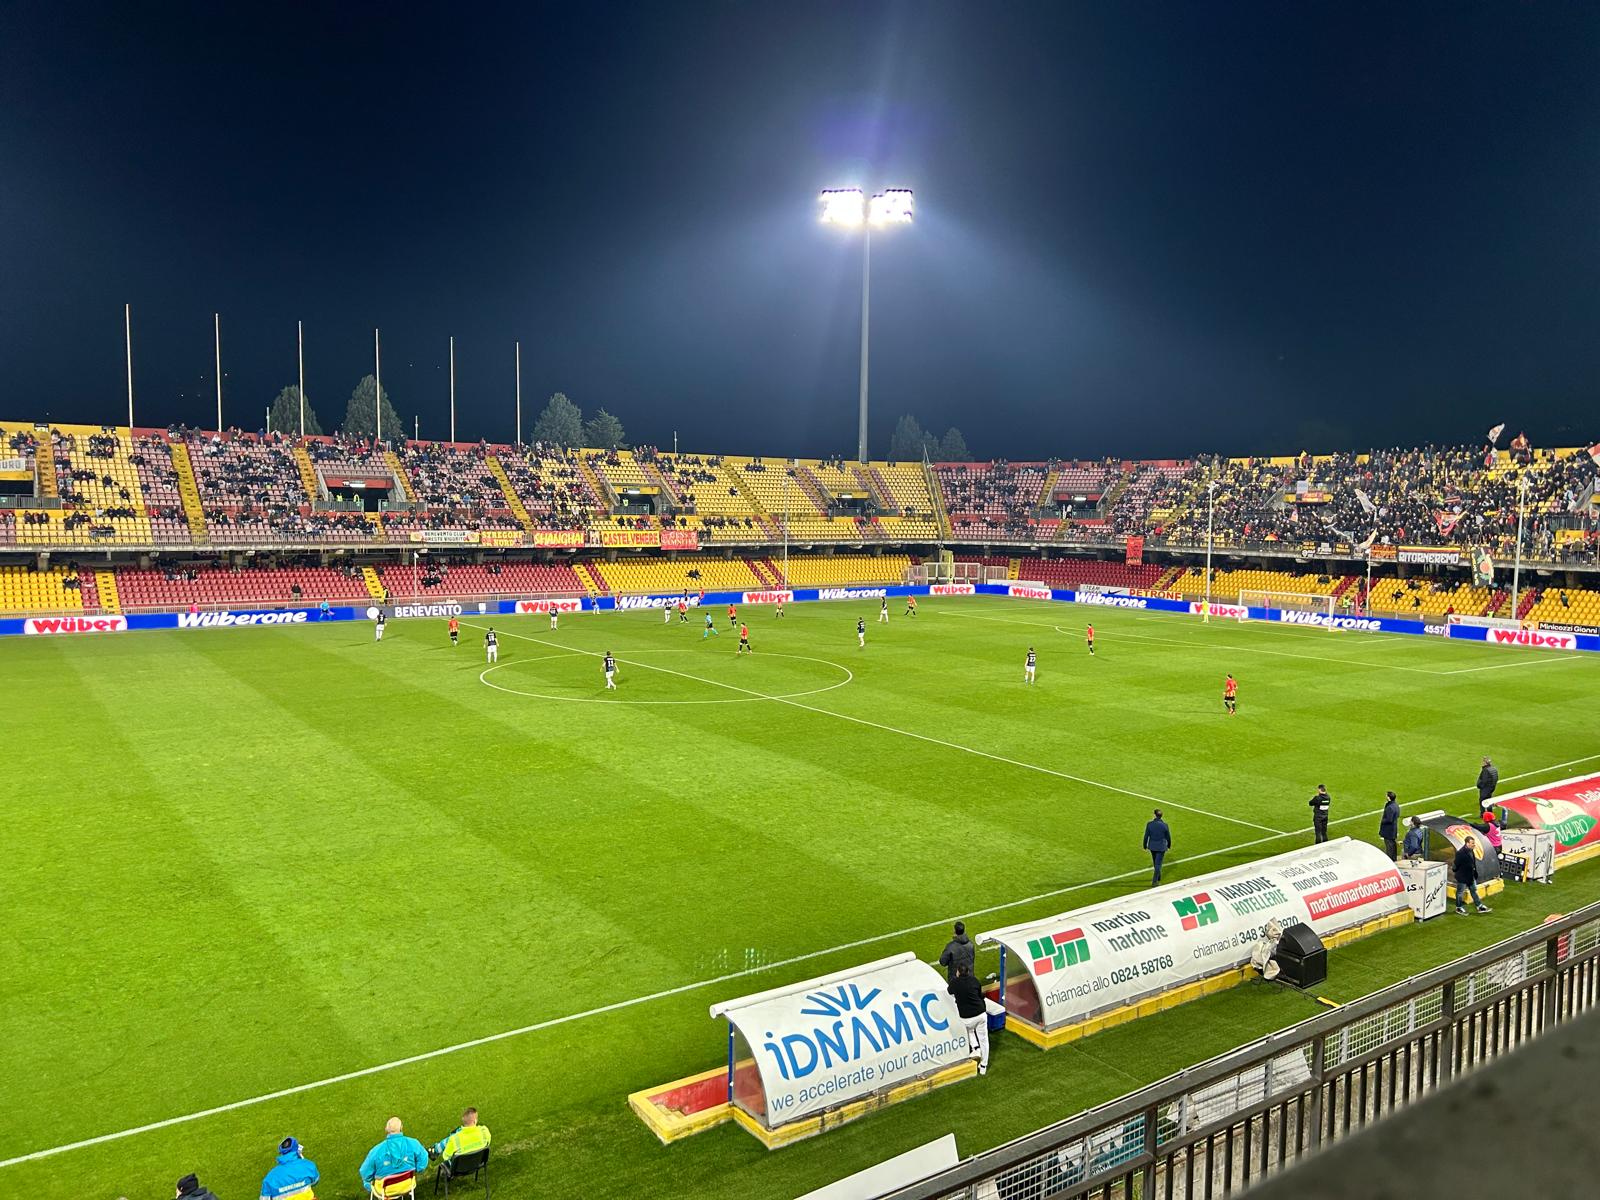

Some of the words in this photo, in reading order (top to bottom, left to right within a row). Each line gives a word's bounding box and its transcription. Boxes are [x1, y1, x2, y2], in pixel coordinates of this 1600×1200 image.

[534, 531, 584, 545] SHANGHAI
[1398, 552, 1459, 564] RITORNEREMO
[746, 592, 790, 603] Wüber
[818, 588, 887, 600] Wüberone
[934, 586, 972, 594] Wüber
[1012, 588, 1049, 599] Wüber
[1129, 588, 1182, 600] PETRONE
[1074, 592, 1147, 608] Wüberone
[178, 611, 307, 627] Wüberone
[395, 605, 462, 617] BENEVENTO
[32, 617, 122, 633] Wüber
[1280, 610, 1381, 630] Wüberone
[1494, 629, 1571, 647] Wüber
[1574, 626, 1597, 634] Gianni
[1553, 819, 1589, 844] MAURO
[1214, 876, 1277, 902] NARDONE
[1292, 876, 1322, 892] nuovo
[1319, 870, 1338, 883] sito
[1230, 888, 1288, 917] HOTELLERIE
[1309, 874, 1401, 915] martinonardone.com
[1091, 908, 1150, 932] martino
[1108, 924, 1168, 952] nardone
[1193, 937, 1230, 959] chiamaci
[1240, 928, 1258, 944] 348
[1046, 983, 1091, 1007] chiamaci
[1092, 976, 1110, 992] allo
[1110, 965, 1139, 985] 0824
[1141, 954, 1173, 975] 58768
[771, 1094, 794, 1112] we
[799, 1066, 875, 1103] accelerate
[879, 1057, 908, 1080] your
[912, 1035, 966, 1064] advance
